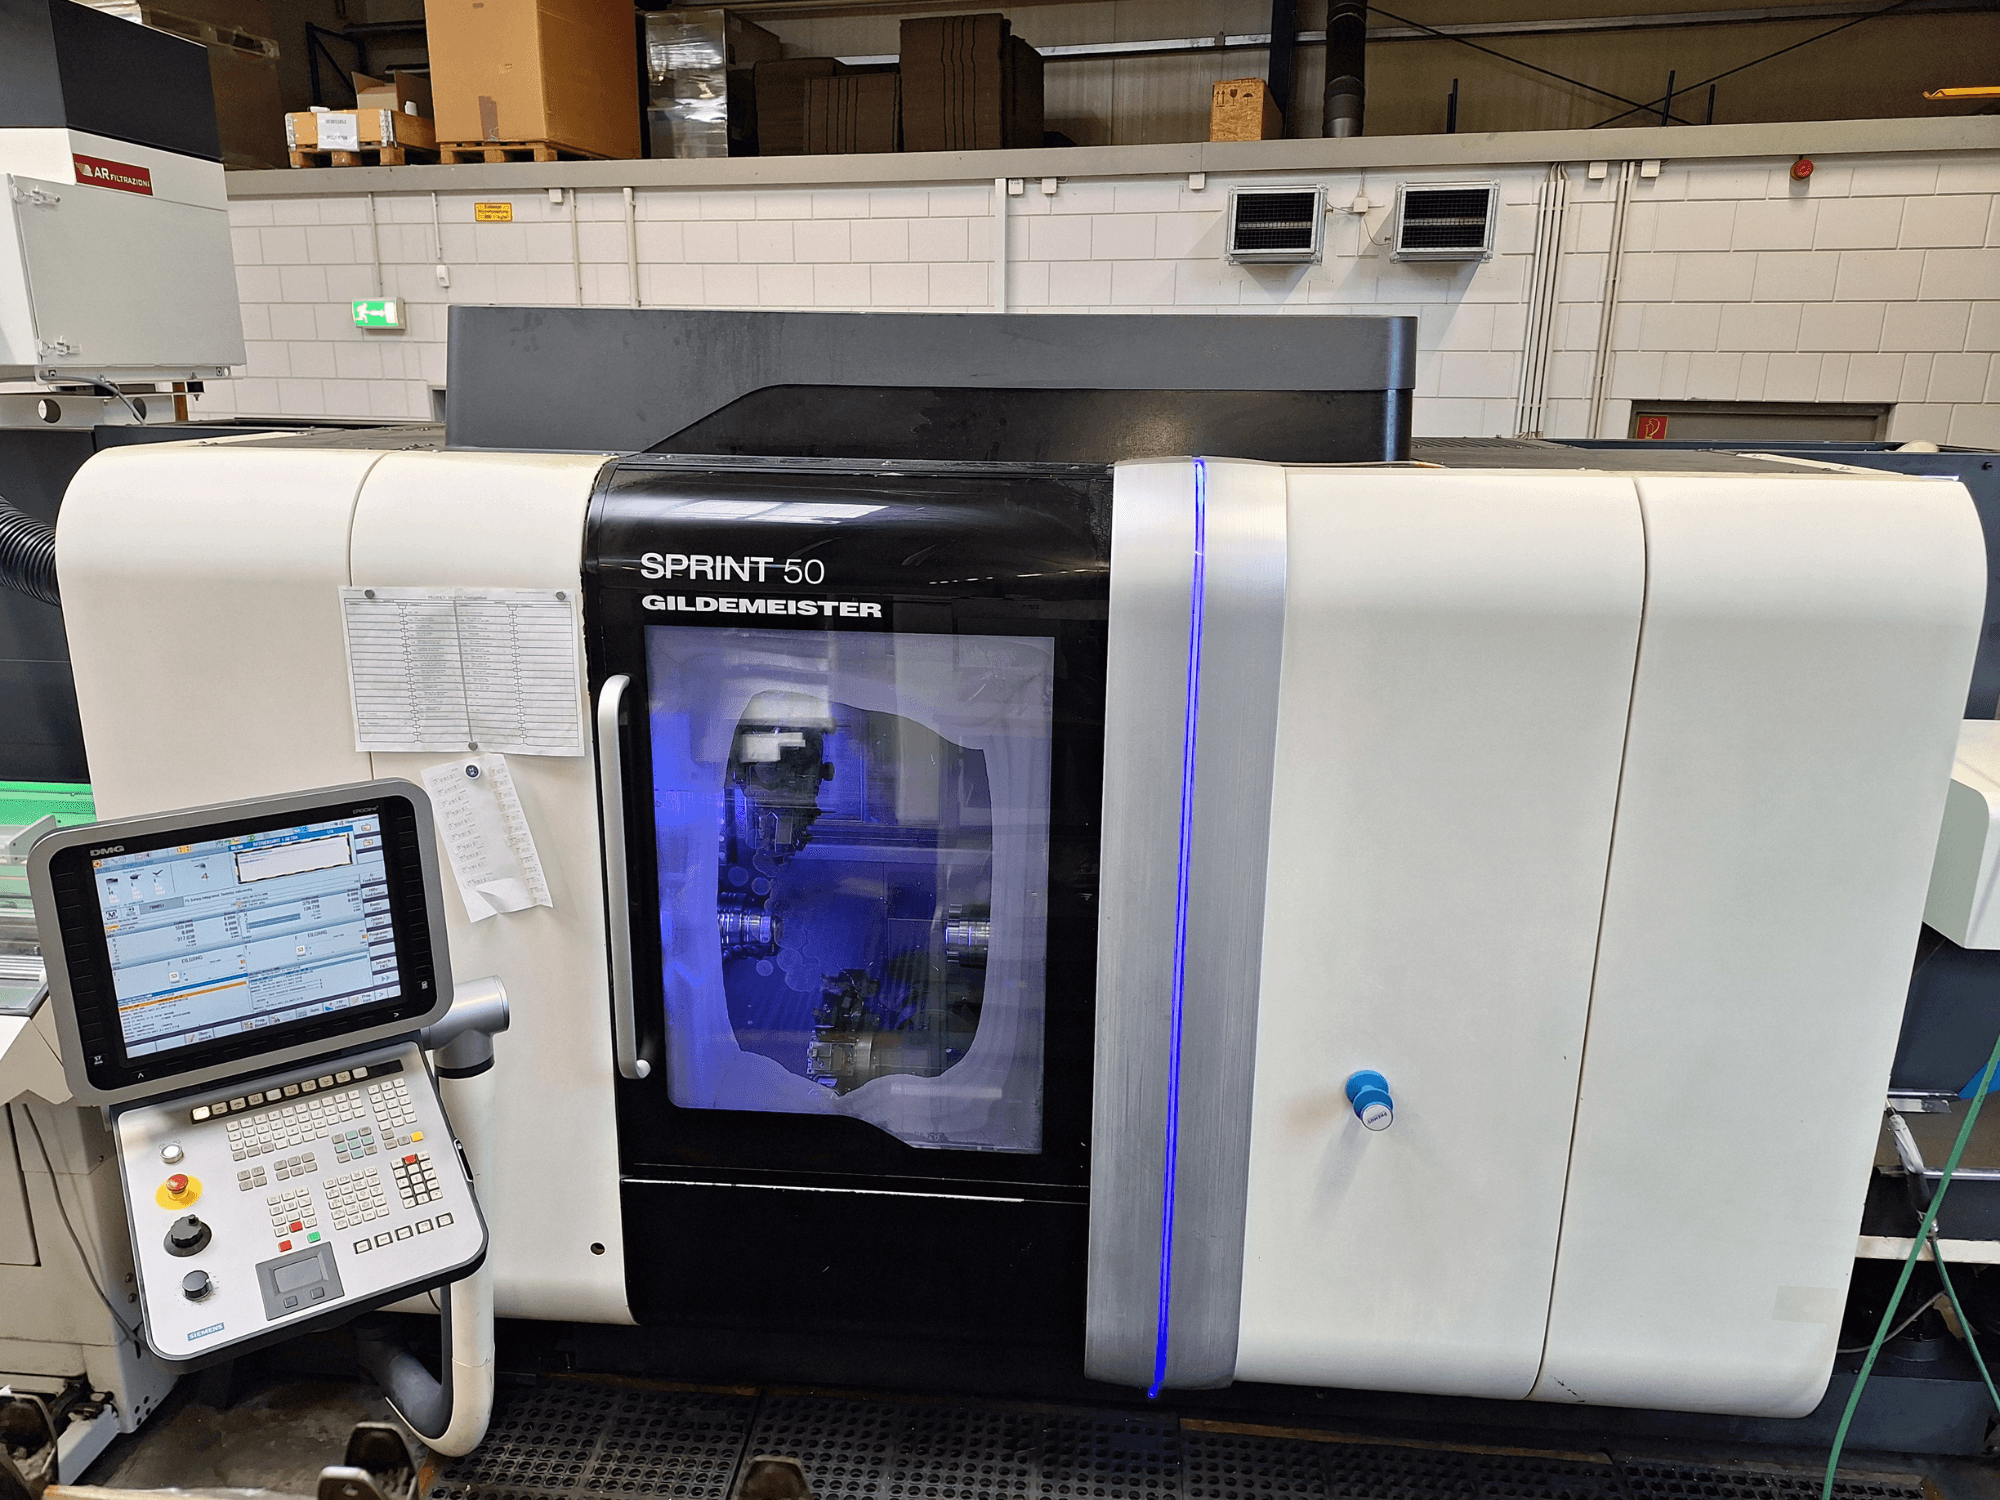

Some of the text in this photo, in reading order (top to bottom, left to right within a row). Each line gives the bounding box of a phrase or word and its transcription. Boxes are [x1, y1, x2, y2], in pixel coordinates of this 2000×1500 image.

[94, 166, 151, 187] AR FILTRAZIONI
[641, 552, 825, 584] SPRINT 50
[642, 595, 882, 618] GILDEMEISTER
[90, 845, 125, 857] DMG
[200, 871, 209, 880] 4
[188, 1323, 224, 1340] SIEMENS
